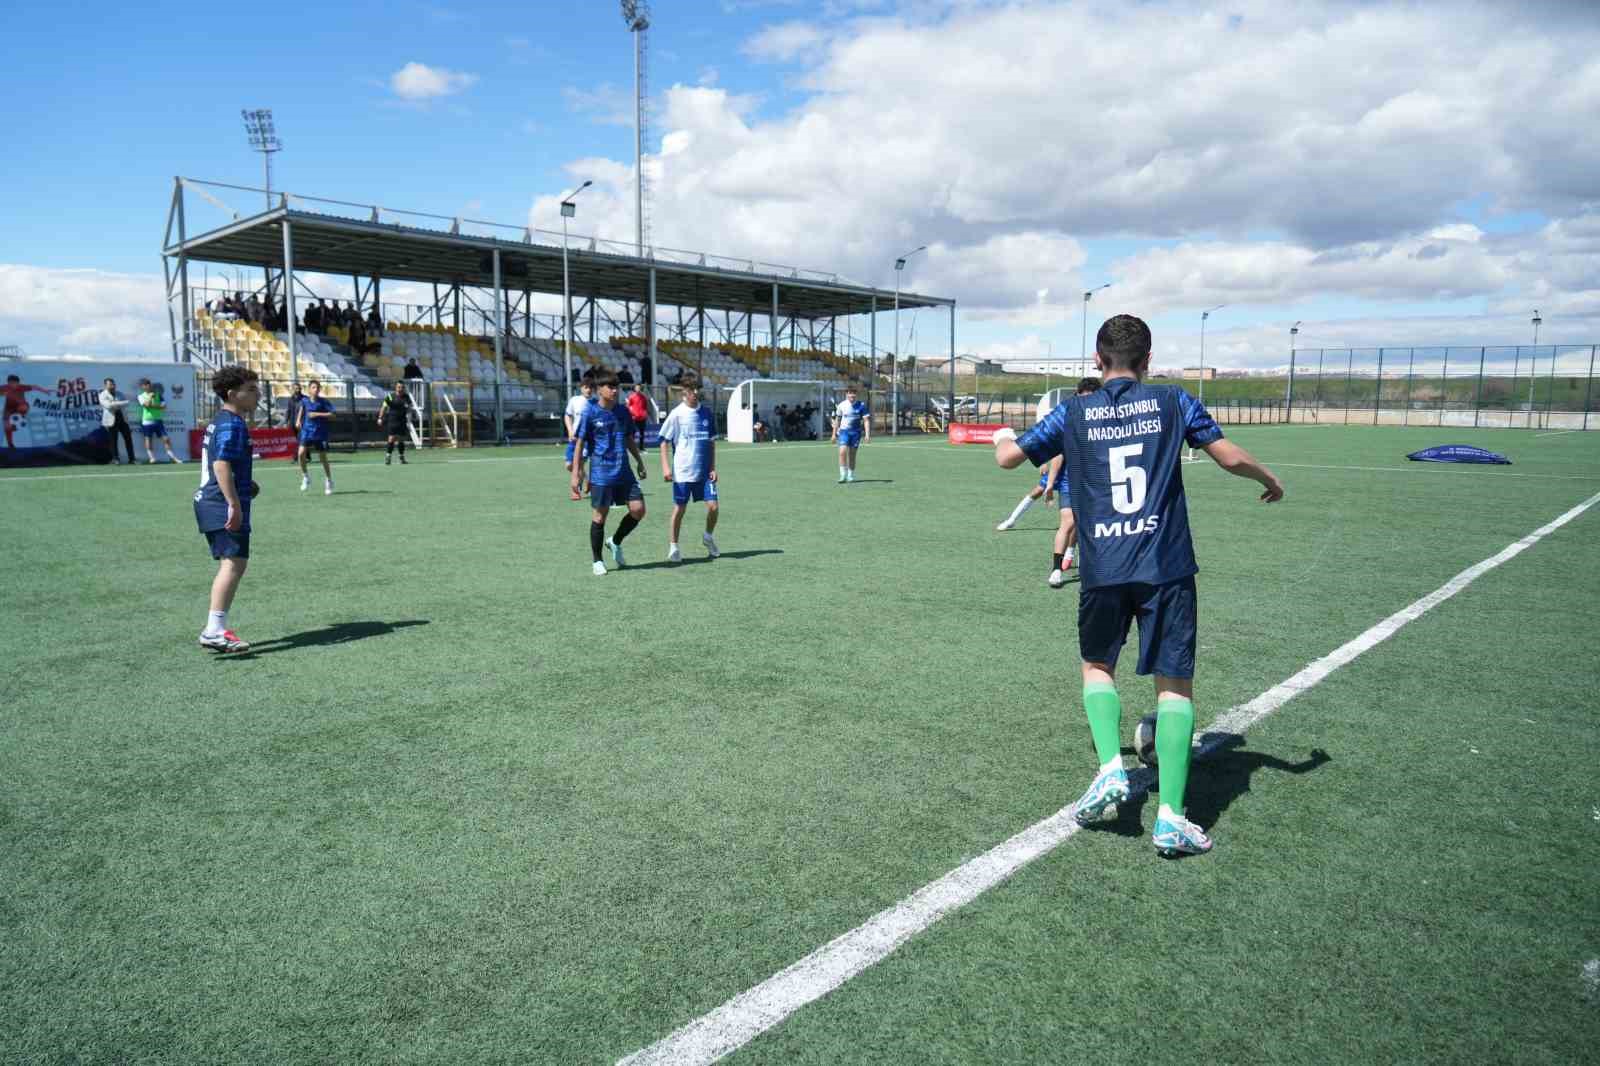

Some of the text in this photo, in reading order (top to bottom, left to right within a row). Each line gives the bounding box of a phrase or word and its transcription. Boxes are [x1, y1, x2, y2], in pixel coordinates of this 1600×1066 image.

[57, 377, 86, 398] 5x5
[1085, 406, 1117, 421] BORSA
[1087, 415, 1161, 441] ANADOLU LİSESİ
[1108, 442, 1147, 515] 5
